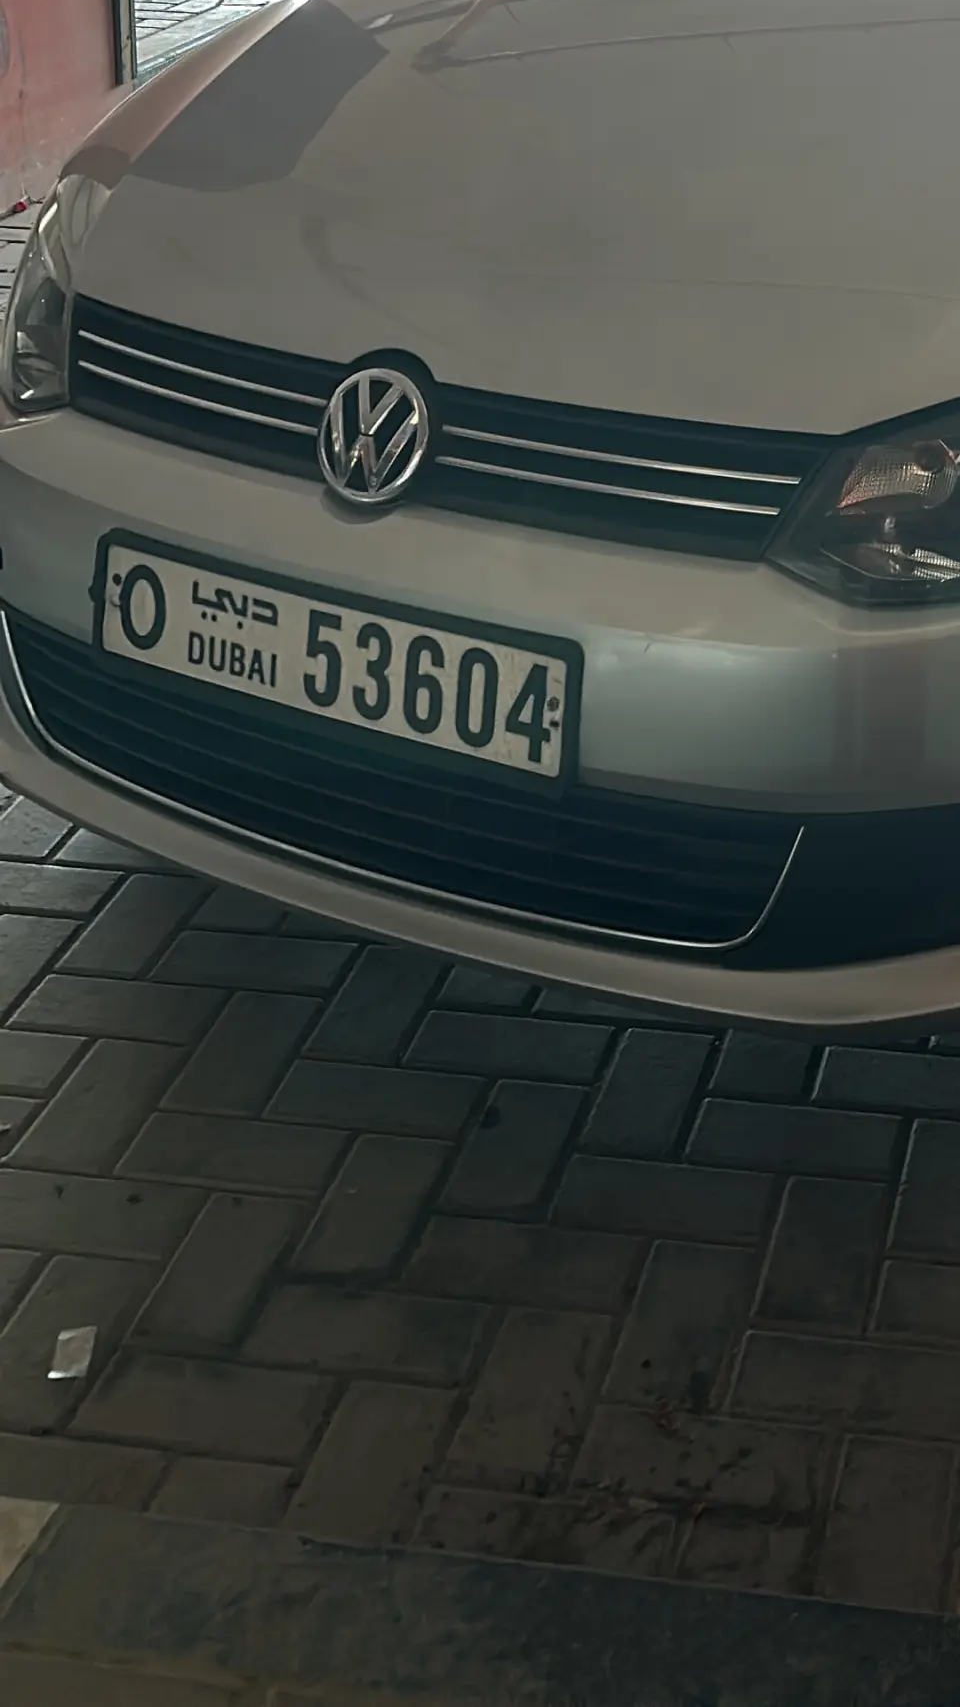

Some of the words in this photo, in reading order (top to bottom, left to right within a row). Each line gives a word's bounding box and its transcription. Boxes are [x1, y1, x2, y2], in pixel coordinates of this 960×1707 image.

[191, 580, 278, 629] دبي
[187, 631, 277, 687] DUBAI
[303, 609, 551, 762] 53604
